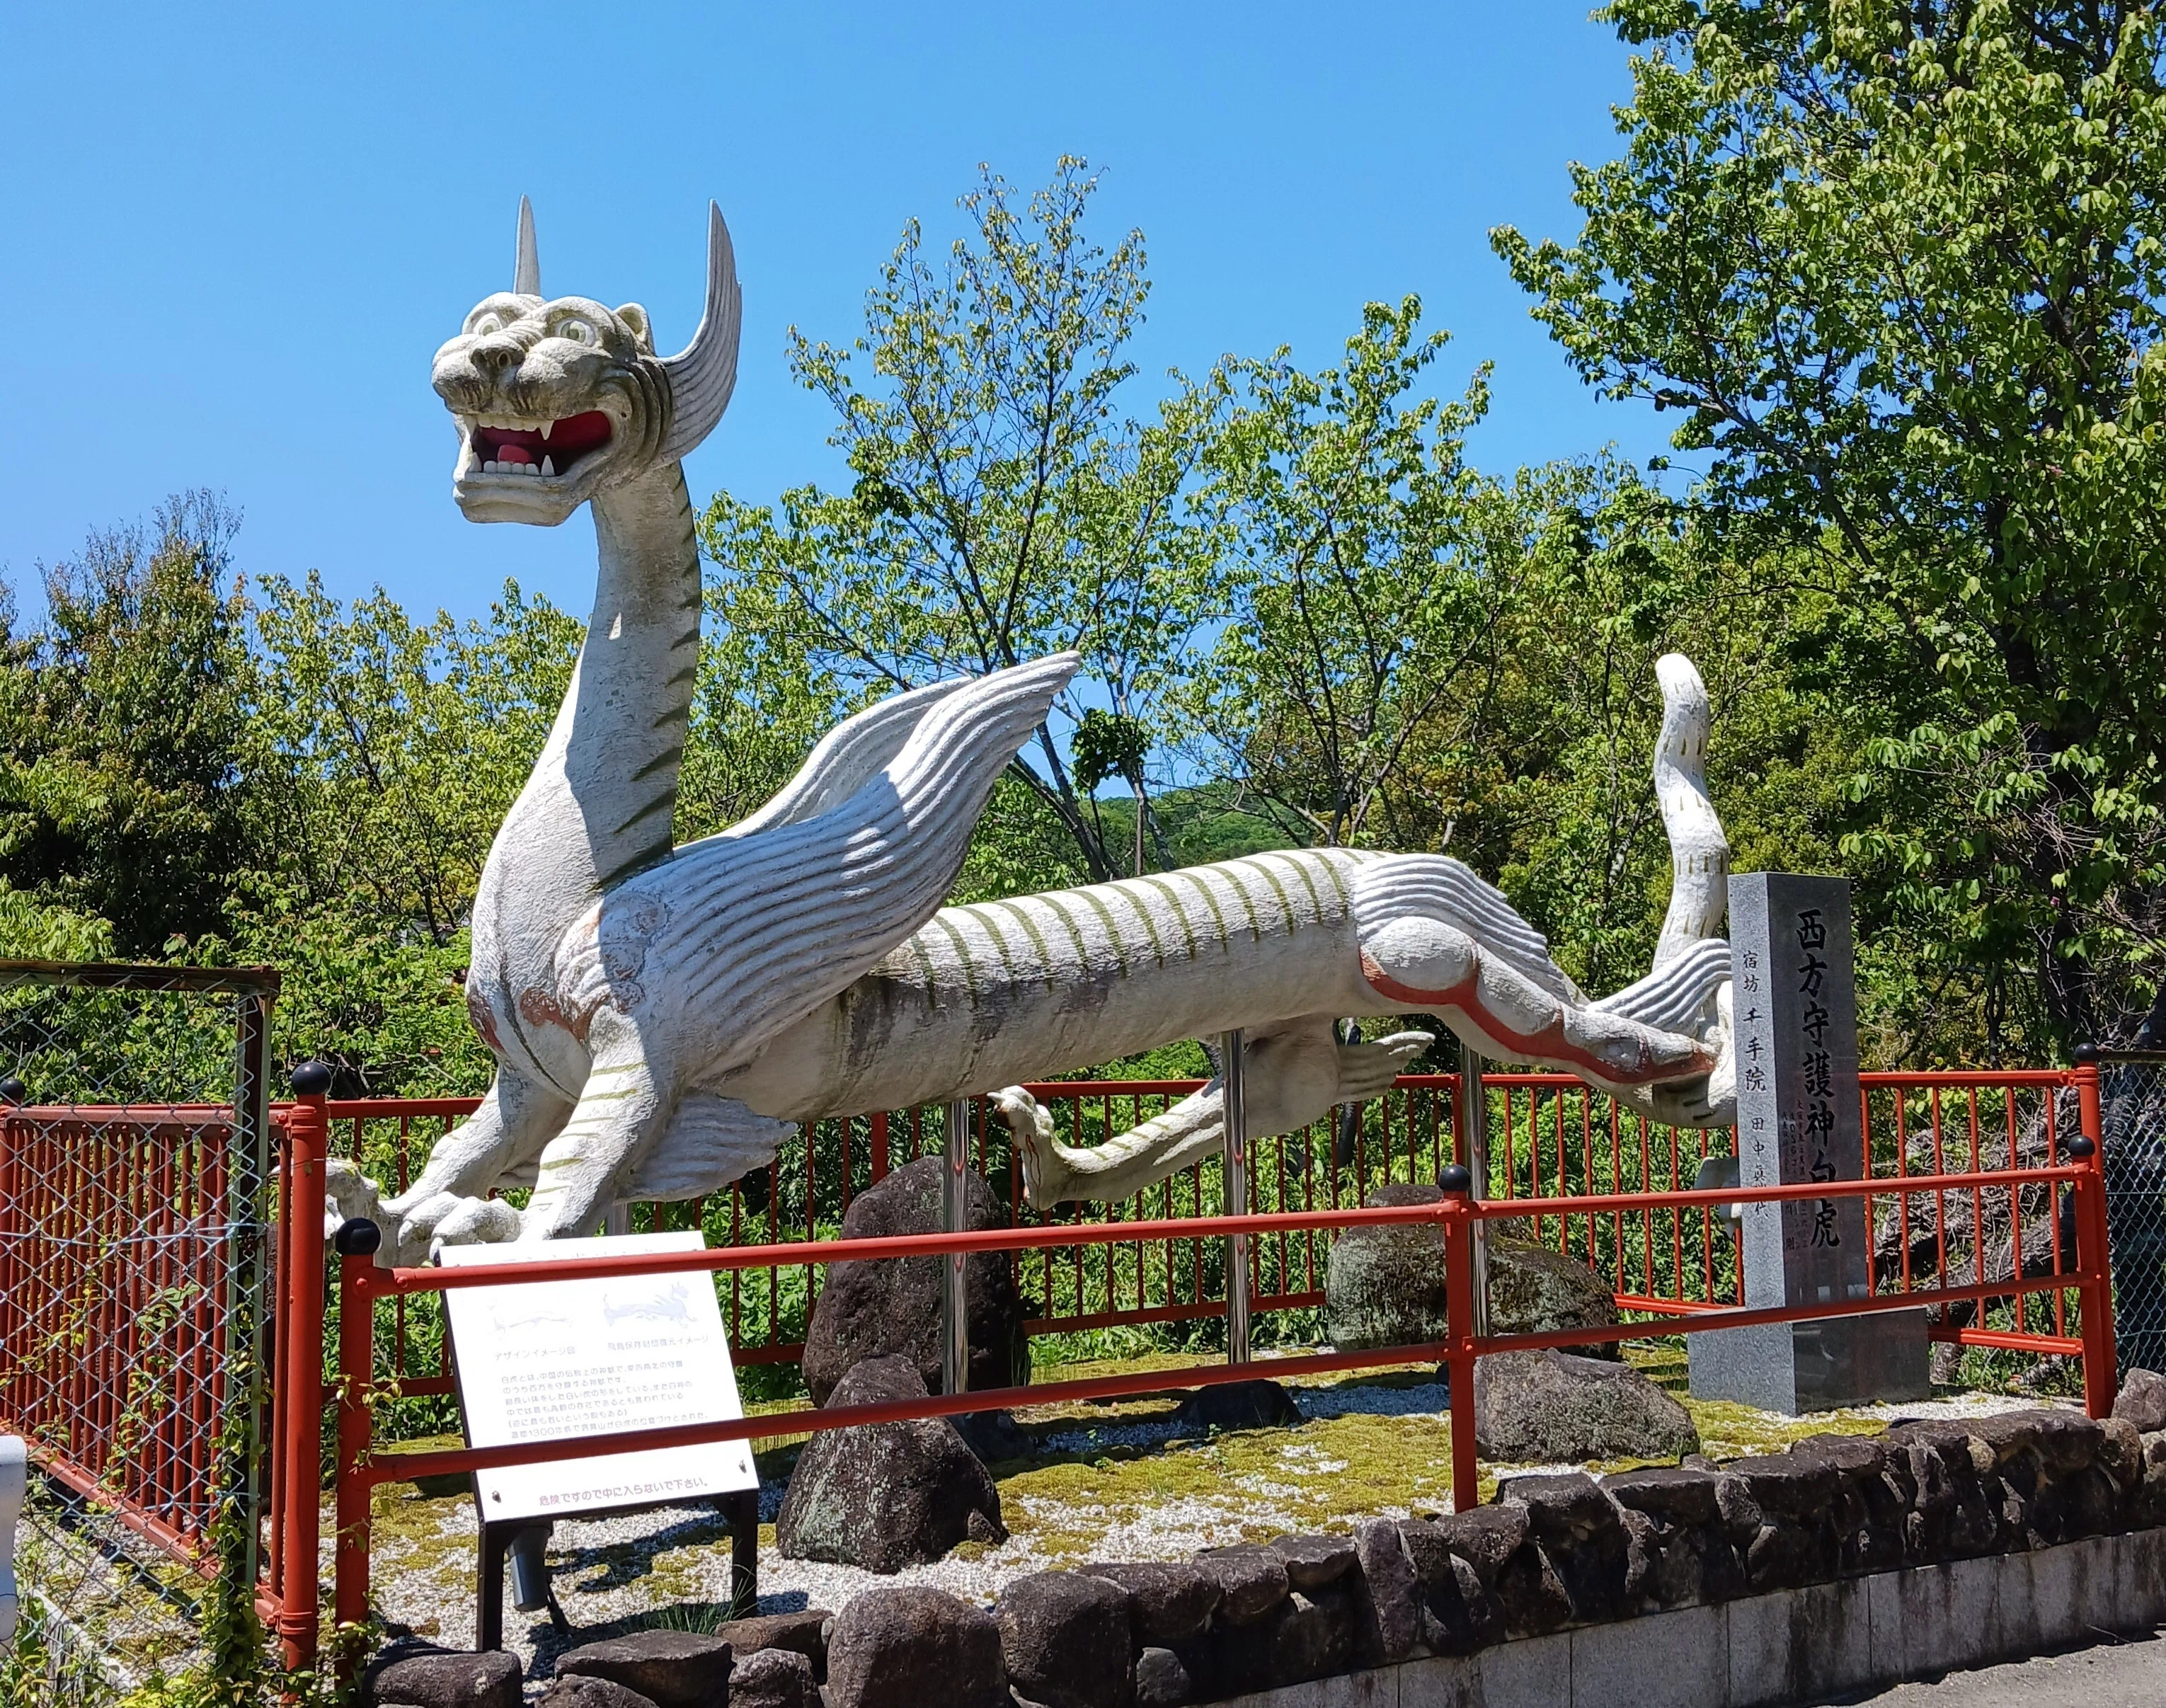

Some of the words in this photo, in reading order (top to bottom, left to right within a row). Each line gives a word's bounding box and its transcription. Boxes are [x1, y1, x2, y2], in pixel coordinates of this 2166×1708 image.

[1743, 950, 1760, 993] 宿坊
[1743, 1007, 1766, 1091] 千手院
[1796, 908, 1840, 1248] 西方守護神白虎
[1750, 1117, 1769, 1218] 田中眞代
[493, 1346, 575, 1361] デザインイメージ図
[539, 1477, 709, 1506] 危険ですので中に入らないで下さい。
